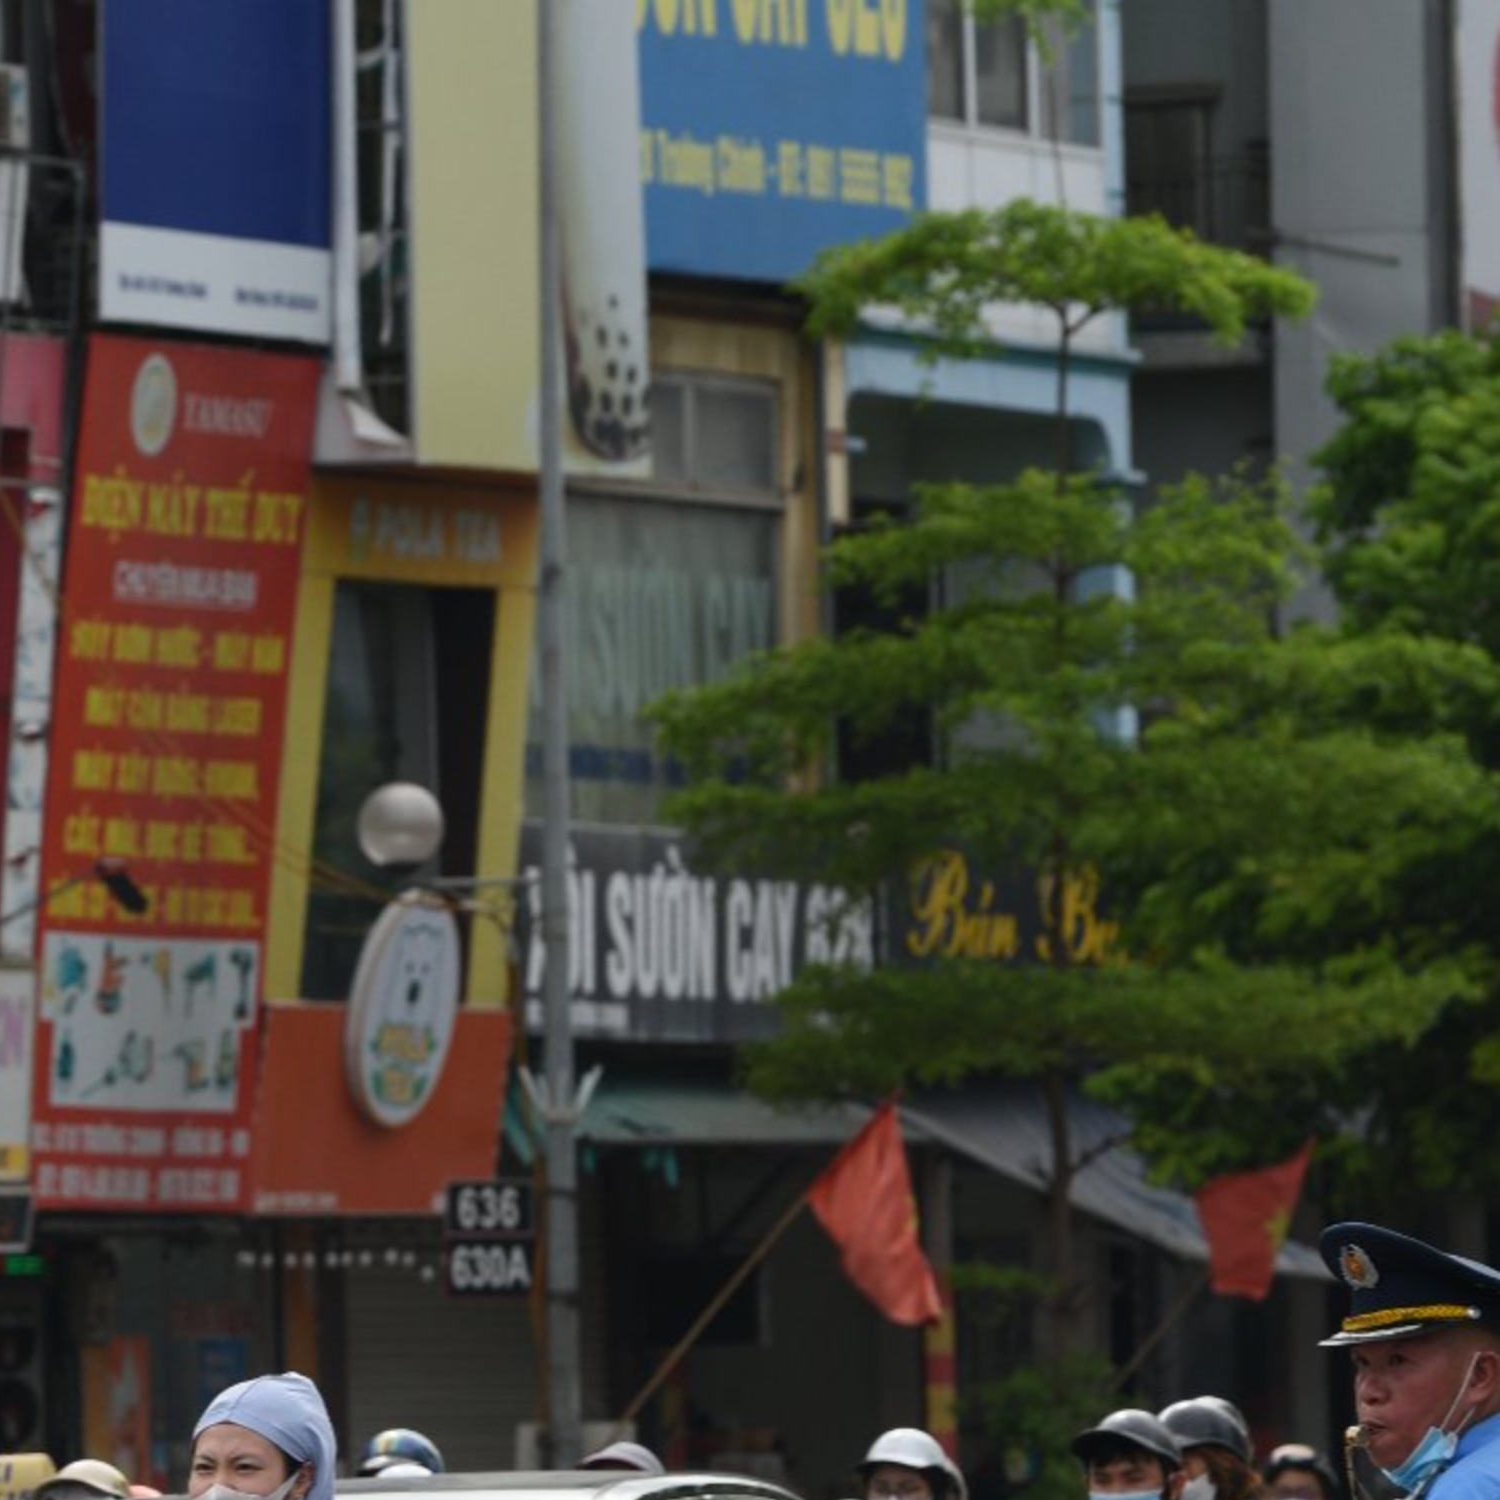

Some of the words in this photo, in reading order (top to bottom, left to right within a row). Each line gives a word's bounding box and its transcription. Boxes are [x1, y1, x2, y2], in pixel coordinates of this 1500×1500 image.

[605, 843, 717, 1000] SƯỜN
[725, 878, 797, 1001] CAY
[457, 1186, 520, 1228] 636
[451, 1243, 531, 1289] 630A
